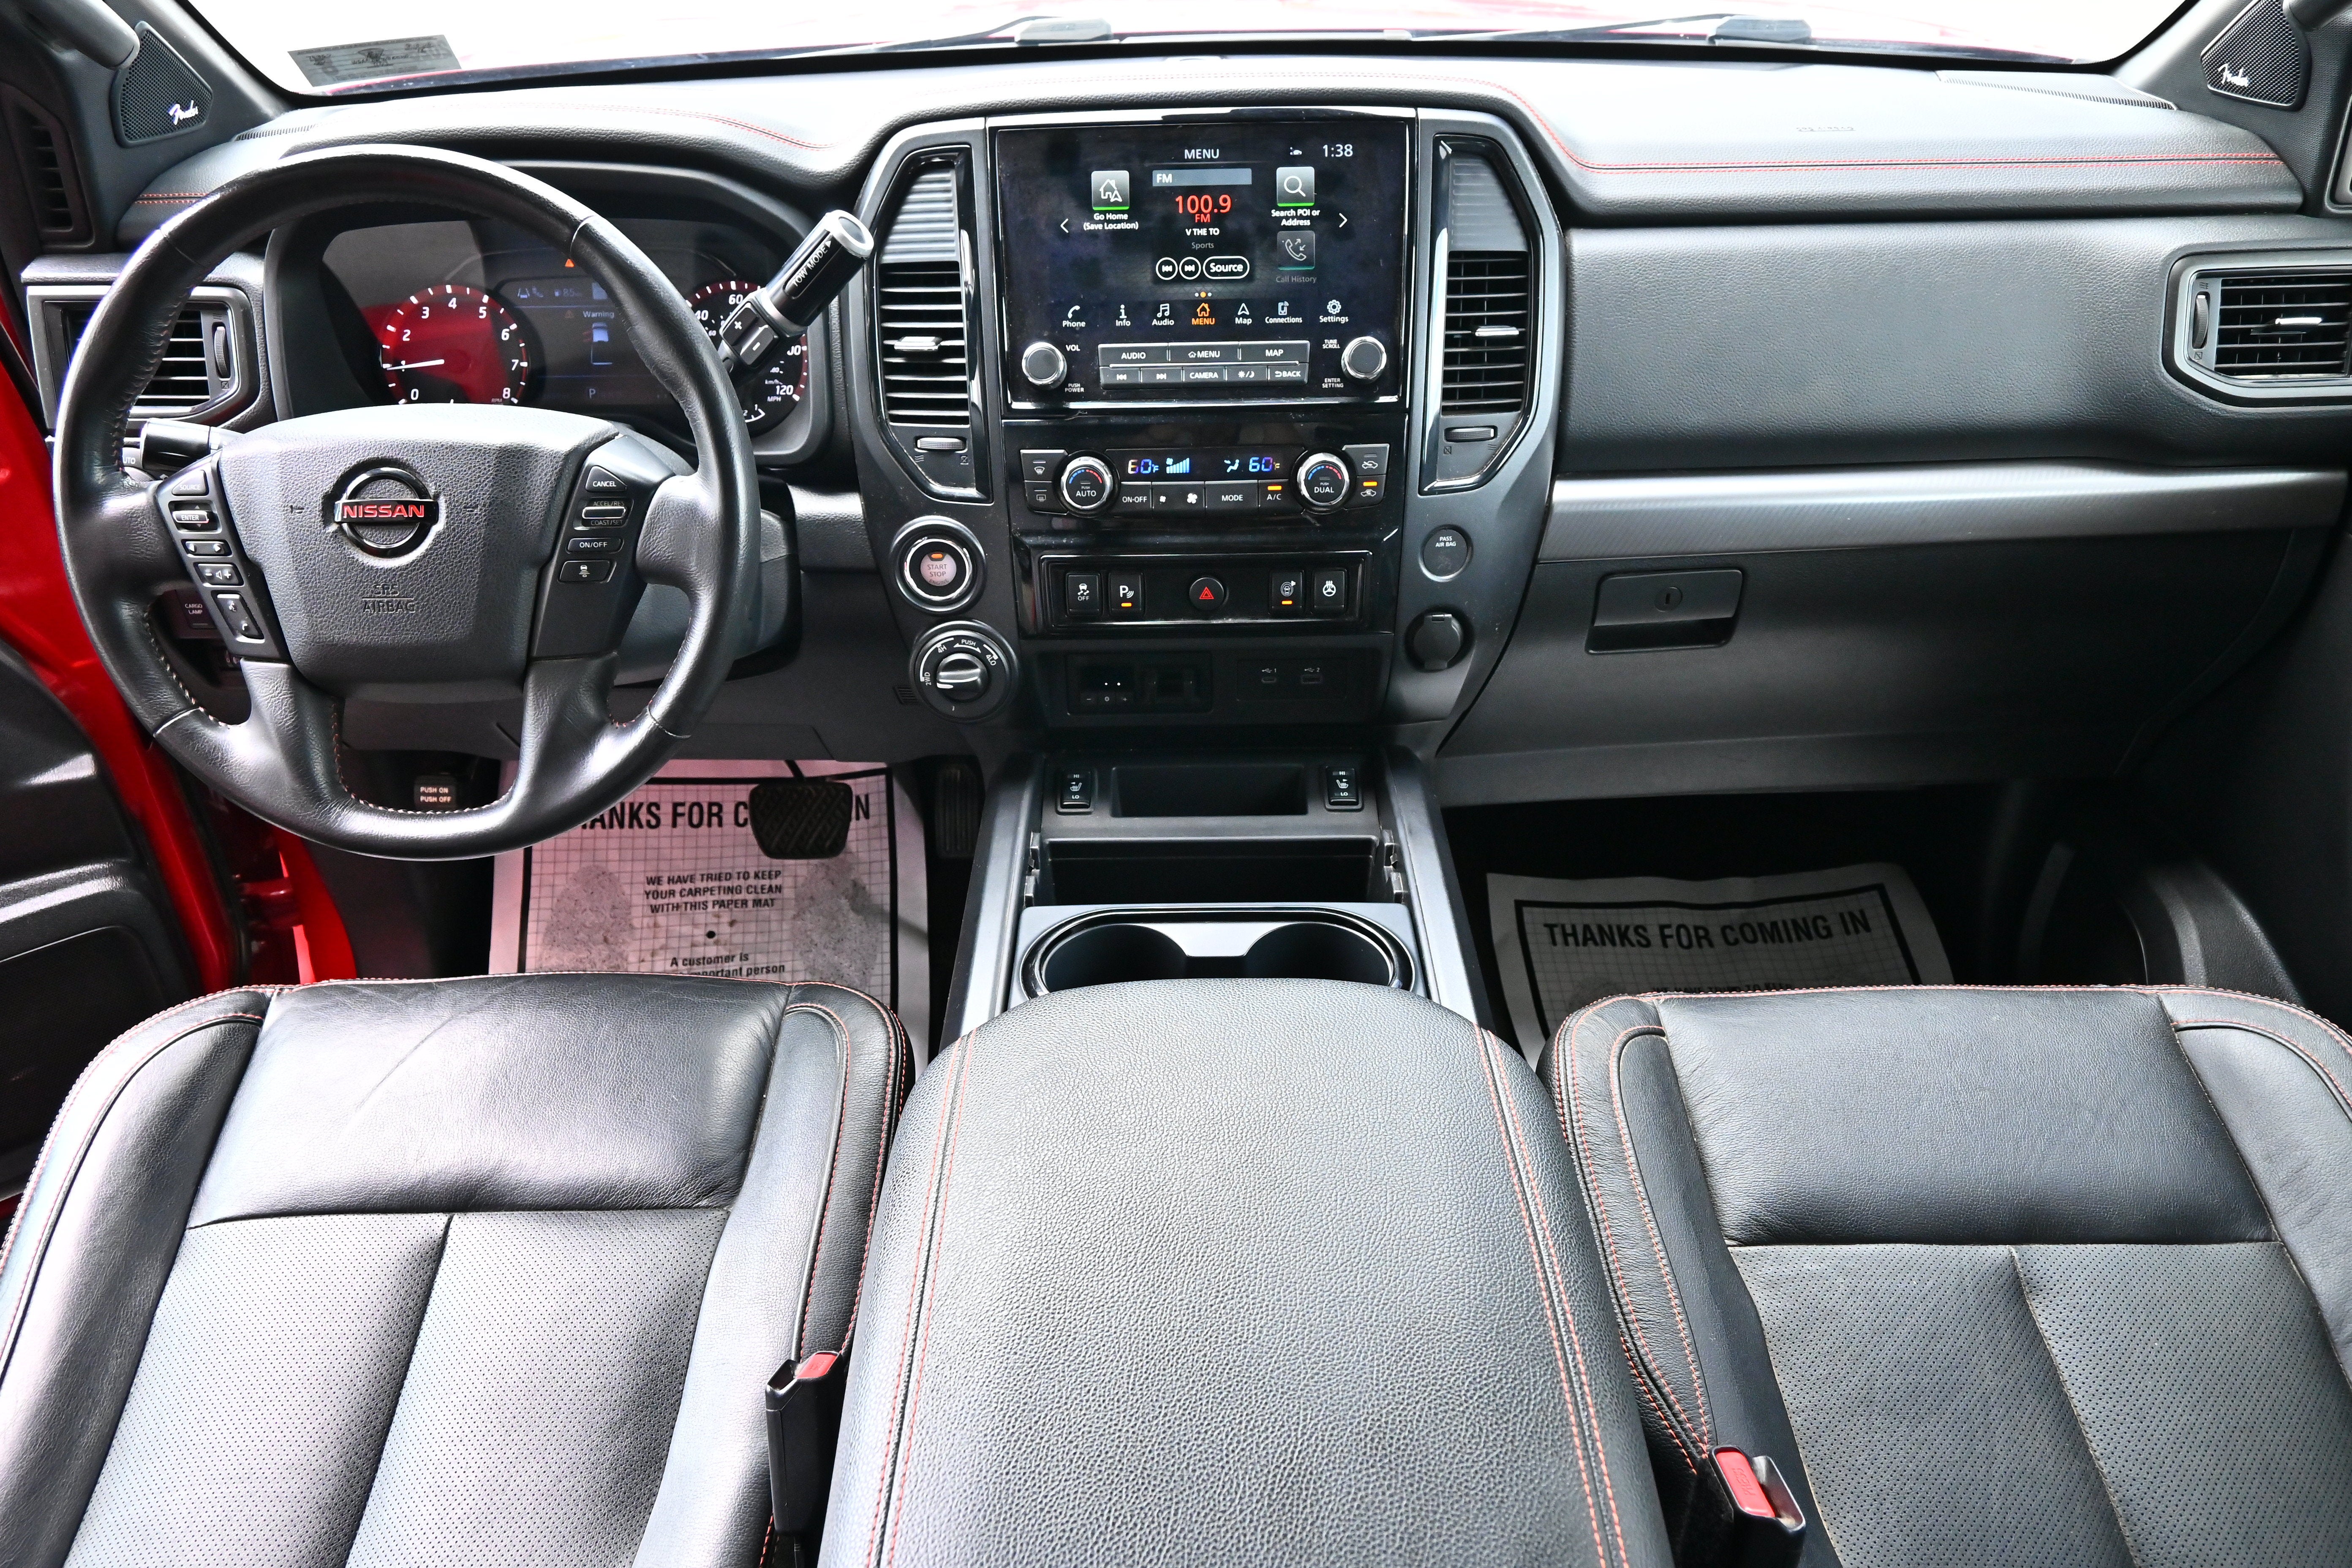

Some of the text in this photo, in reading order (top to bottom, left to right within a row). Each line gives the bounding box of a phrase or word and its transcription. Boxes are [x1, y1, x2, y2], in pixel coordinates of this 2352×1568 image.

[1184, 149, 1219, 159] MENU
[1323, 144, 1353, 157] 1:38
[1157, 174, 1172, 183] FM
[1176, 195, 1231, 213] 100.9
[1195, 214, 1211, 223] FM
[1083, 222, 1138, 230] (Save Location)
[792, 245, 828, 287] TOW MODE
[1210, 263, 1243, 273] Source
[448, 298, 457, 309] 4
[729, 294, 743, 305] 60
[422, 307, 429, 318] 3
[479, 307, 487, 318] 5
[1235, 317, 1252, 325] Map
[1319, 316, 1349, 324] Settings
[403, 329, 411, 341] 2
[501, 329, 509, 340] 6
[512, 359, 519, 370] 7
[411, 389, 419, 400] 0
[503, 387, 510, 399] 8
[589, 389, 595, 398] P
[776, 385, 794, 395] 120
[343, 504, 424, 518] NISSAN
[373, 583, 400, 596] SRS
[362, 600, 416, 613] AIRBAG
[937, 645, 947, 653] 4H
[985, 654, 996, 666] 4LO
[672, 801, 722, 828] FOR
[646, 870, 781, 886] WE HAVE TRIED TO KEEP
[645, 884, 782, 900] YOUR CARPETING CLEAN
[650, 898, 776, 914] WITH THIS PAPER MAT
[1544, 908, 1872, 950] THANKS FOR COMING IN
[670, 953, 749, 967] A customer is
[746, 964, 785, 977] person
